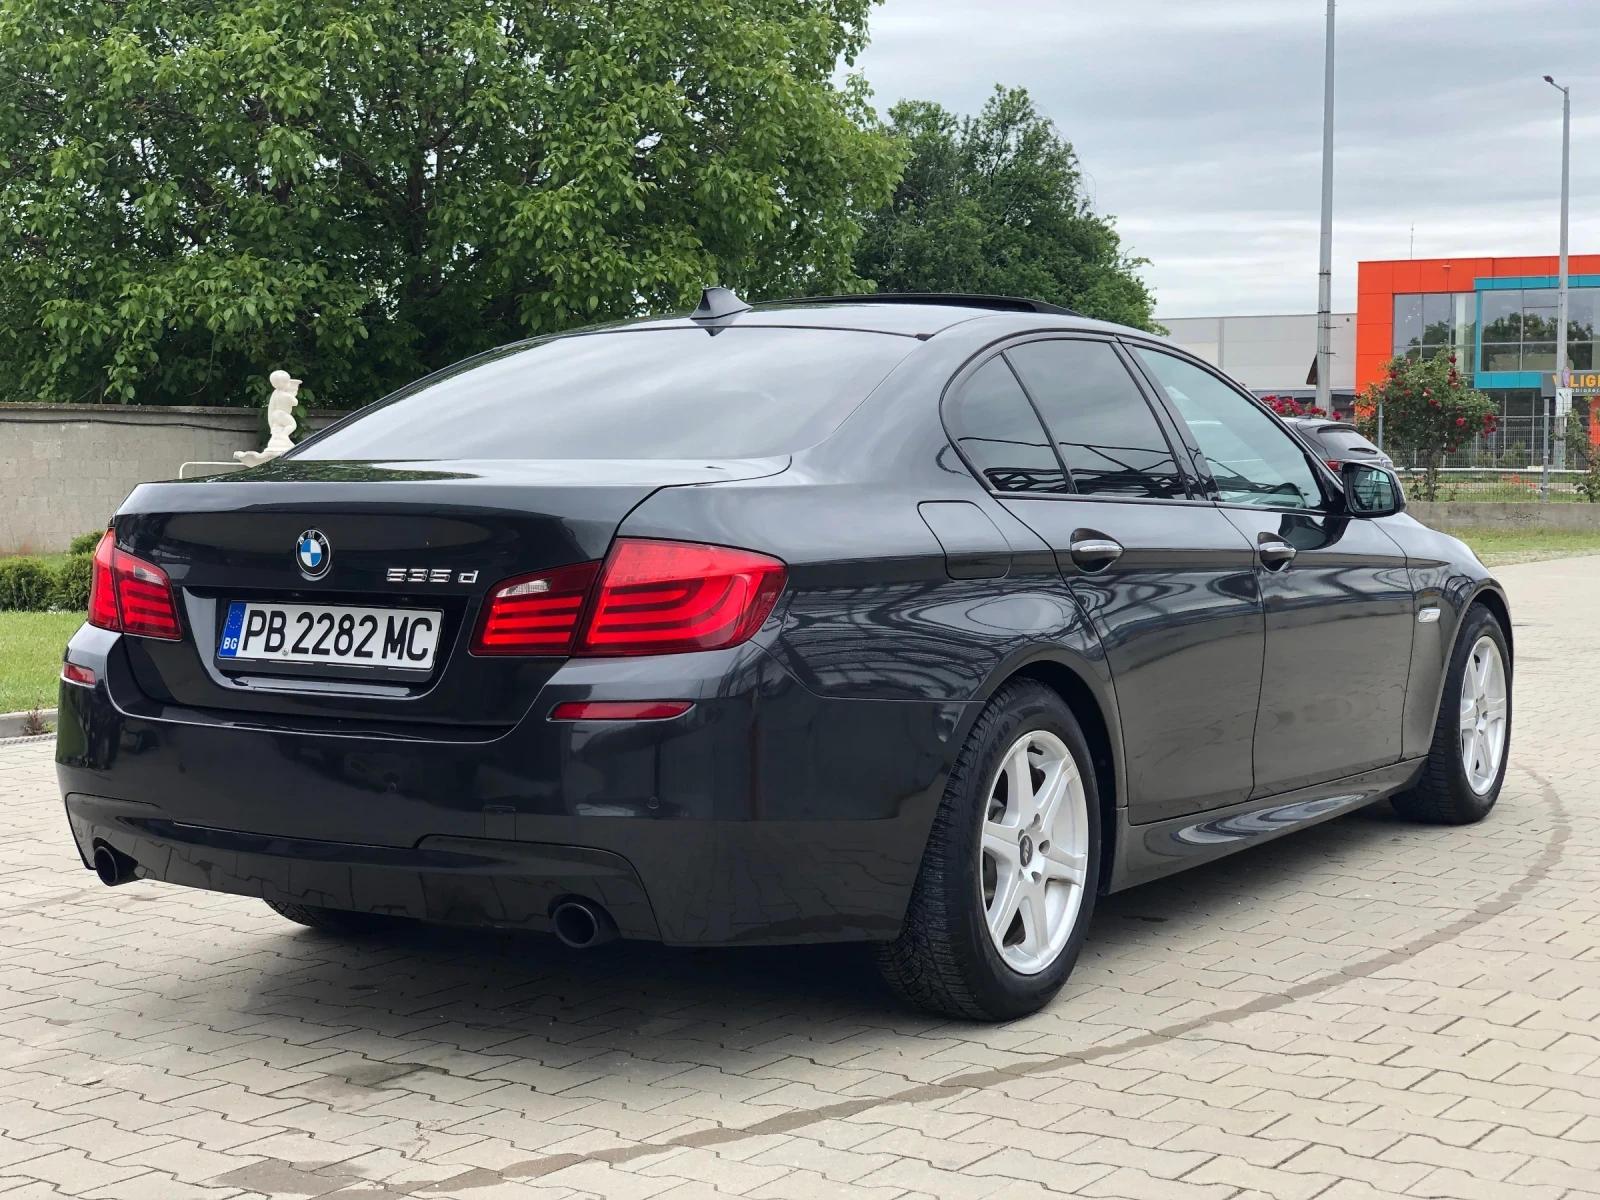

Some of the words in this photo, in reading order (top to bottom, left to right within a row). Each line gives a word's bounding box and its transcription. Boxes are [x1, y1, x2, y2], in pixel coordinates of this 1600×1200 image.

[386, 568, 453, 582] 535
[458, 570, 479, 583] d
[242, 610, 287, 652] PB
[291, 612, 378, 658] 2282
[381, 615, 433, 661] MC
[223, 637, 238, 650] BG
